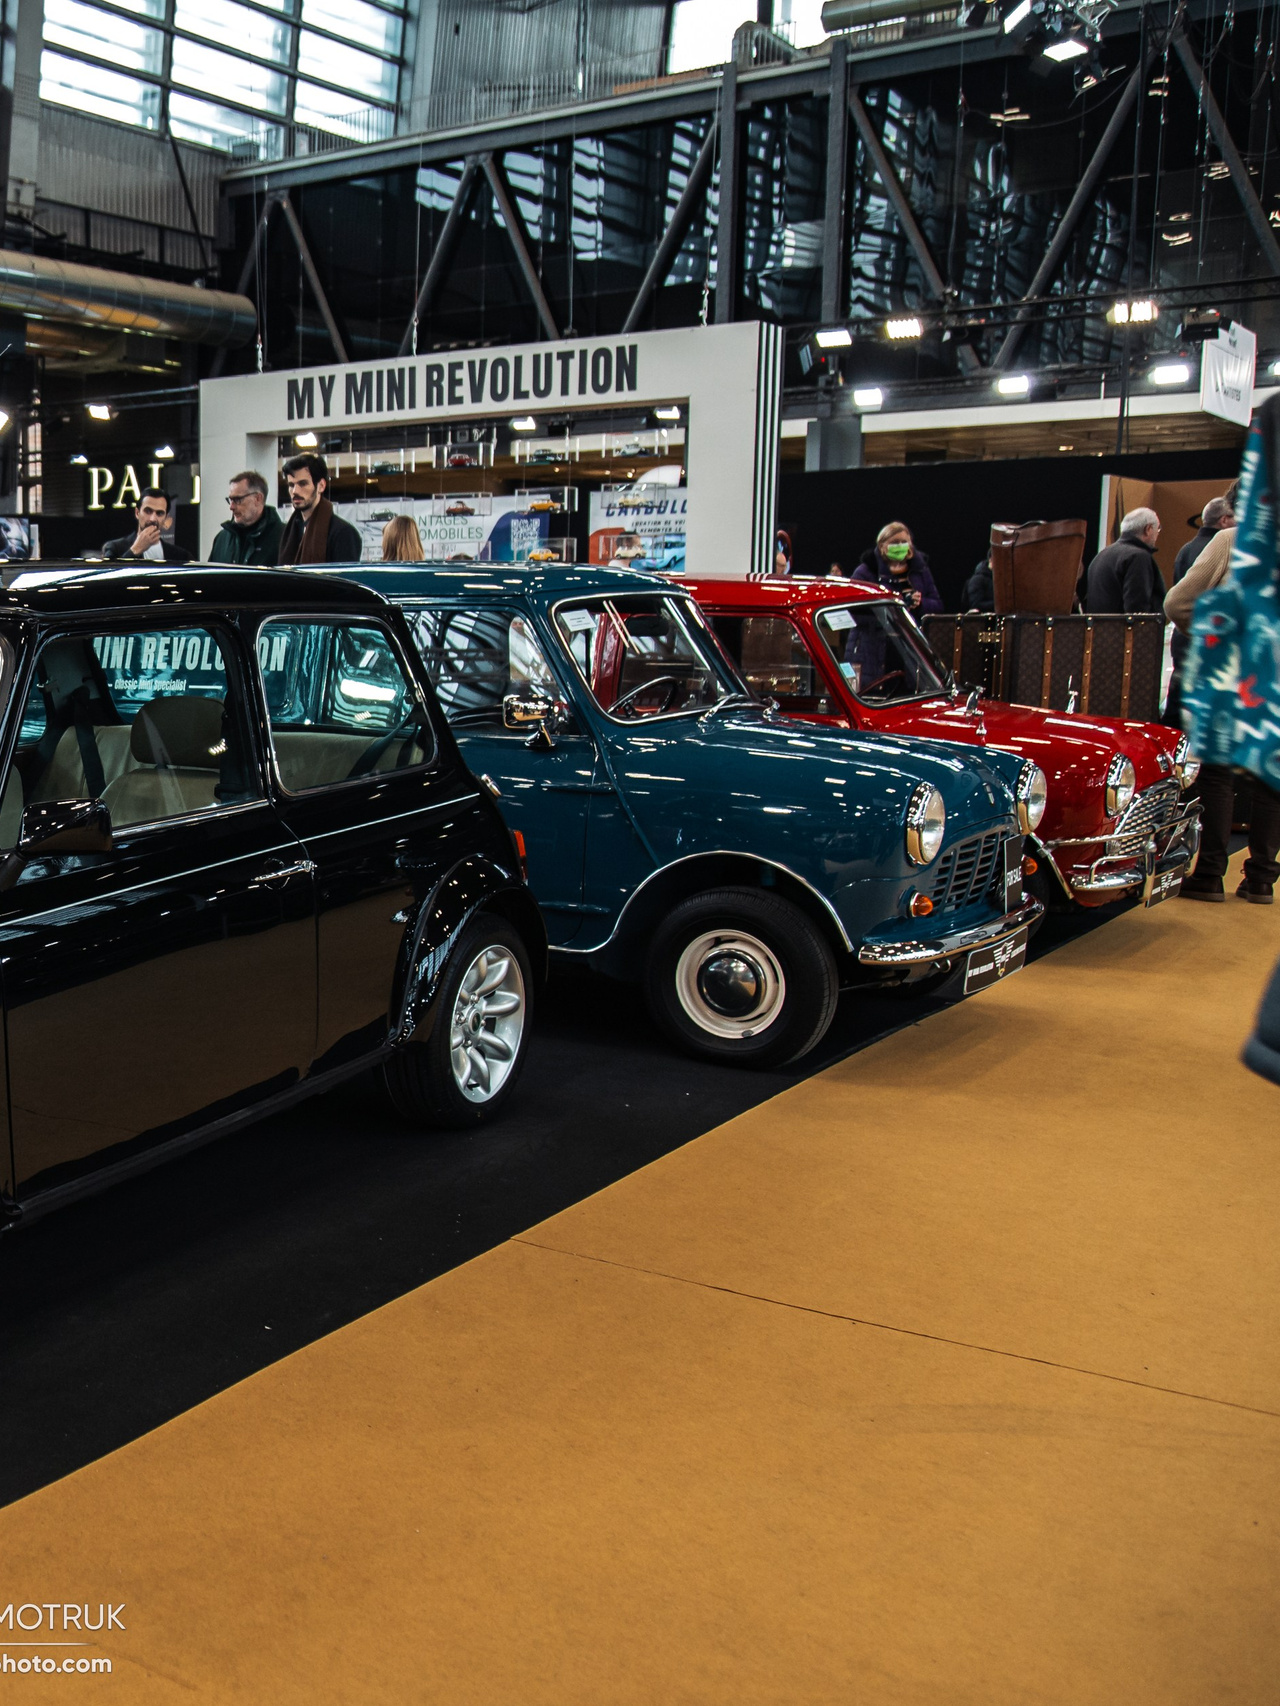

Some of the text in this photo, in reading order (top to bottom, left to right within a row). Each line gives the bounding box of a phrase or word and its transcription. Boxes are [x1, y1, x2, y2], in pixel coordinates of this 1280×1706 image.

[287, 344, 638, 420] MY MINI REVOLUTION
[414, 515, 468, 527] NTAGES
